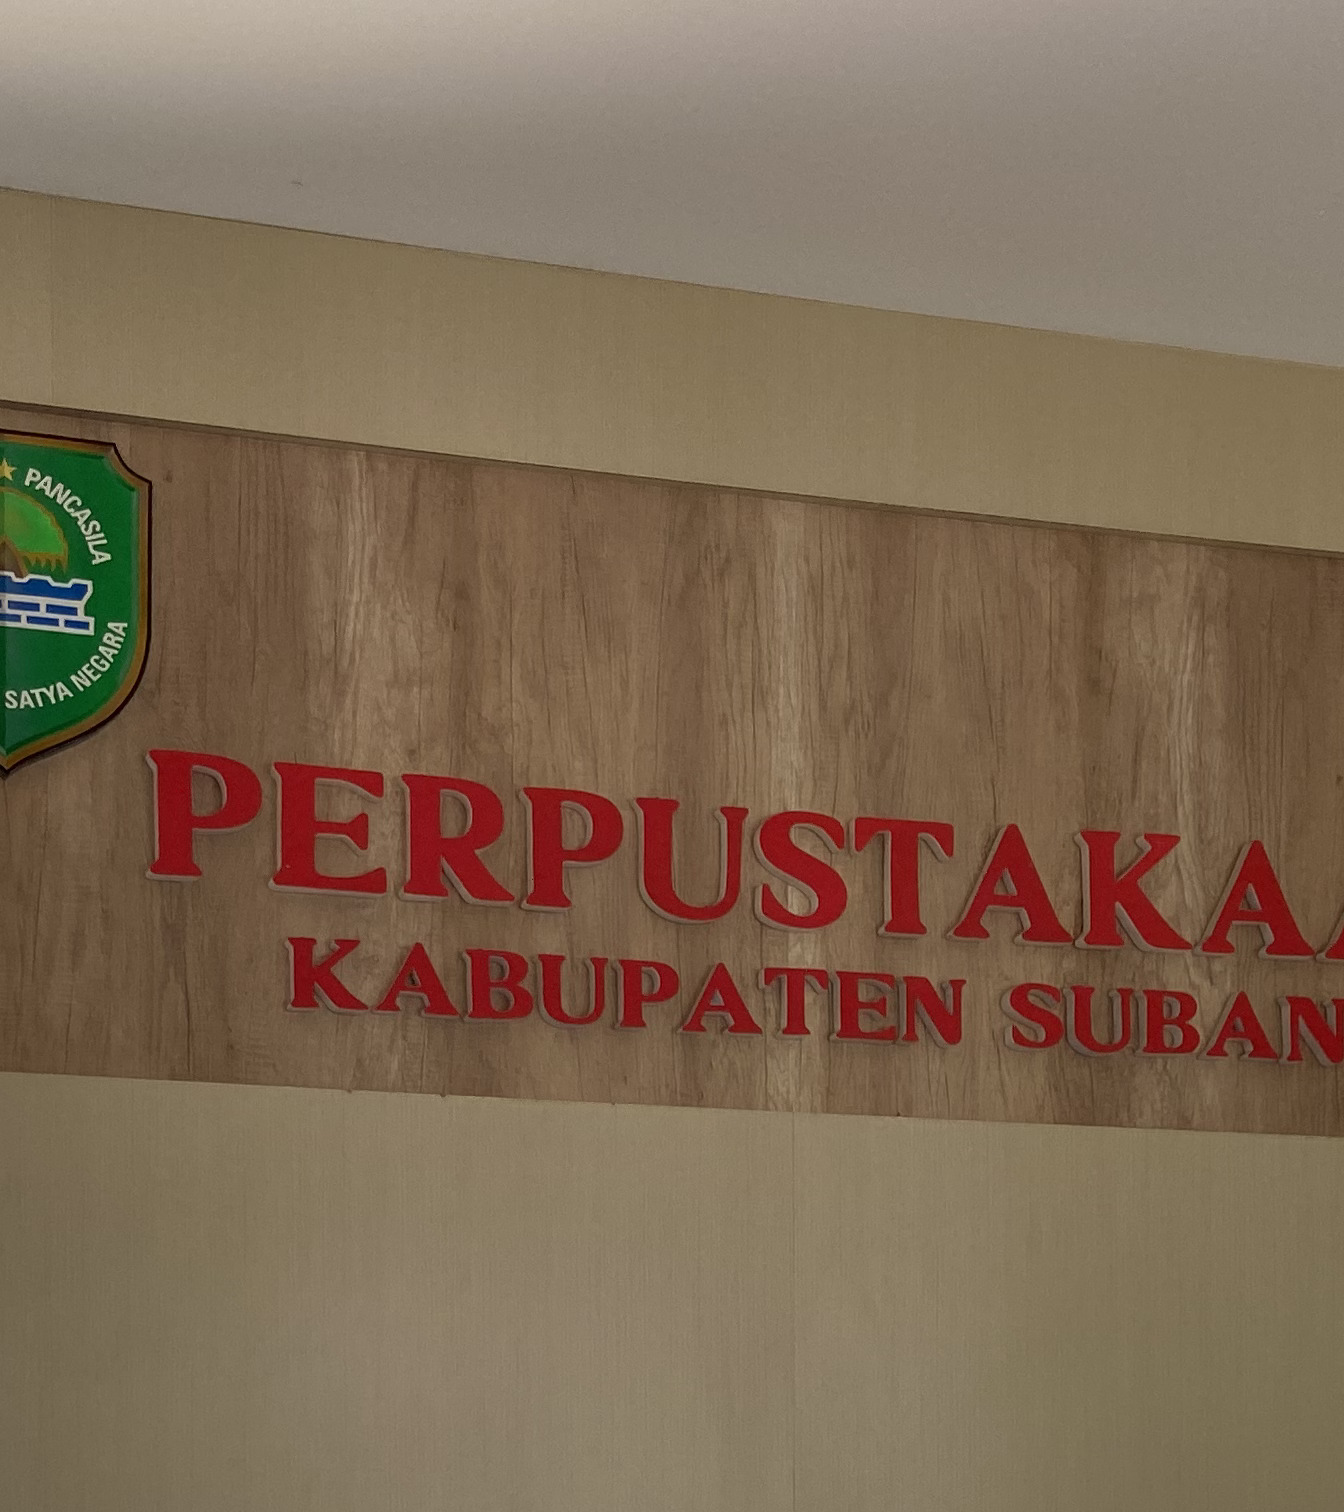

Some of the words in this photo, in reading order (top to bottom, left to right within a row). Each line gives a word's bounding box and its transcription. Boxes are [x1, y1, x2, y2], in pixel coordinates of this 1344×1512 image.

[24, 467, 112, 565] PANCASILA
[4, 681, 74, 709] SATYA
[70, 621, 128, 692] NEGARA
[286, 936, 967, 1046] KABUPATEN
